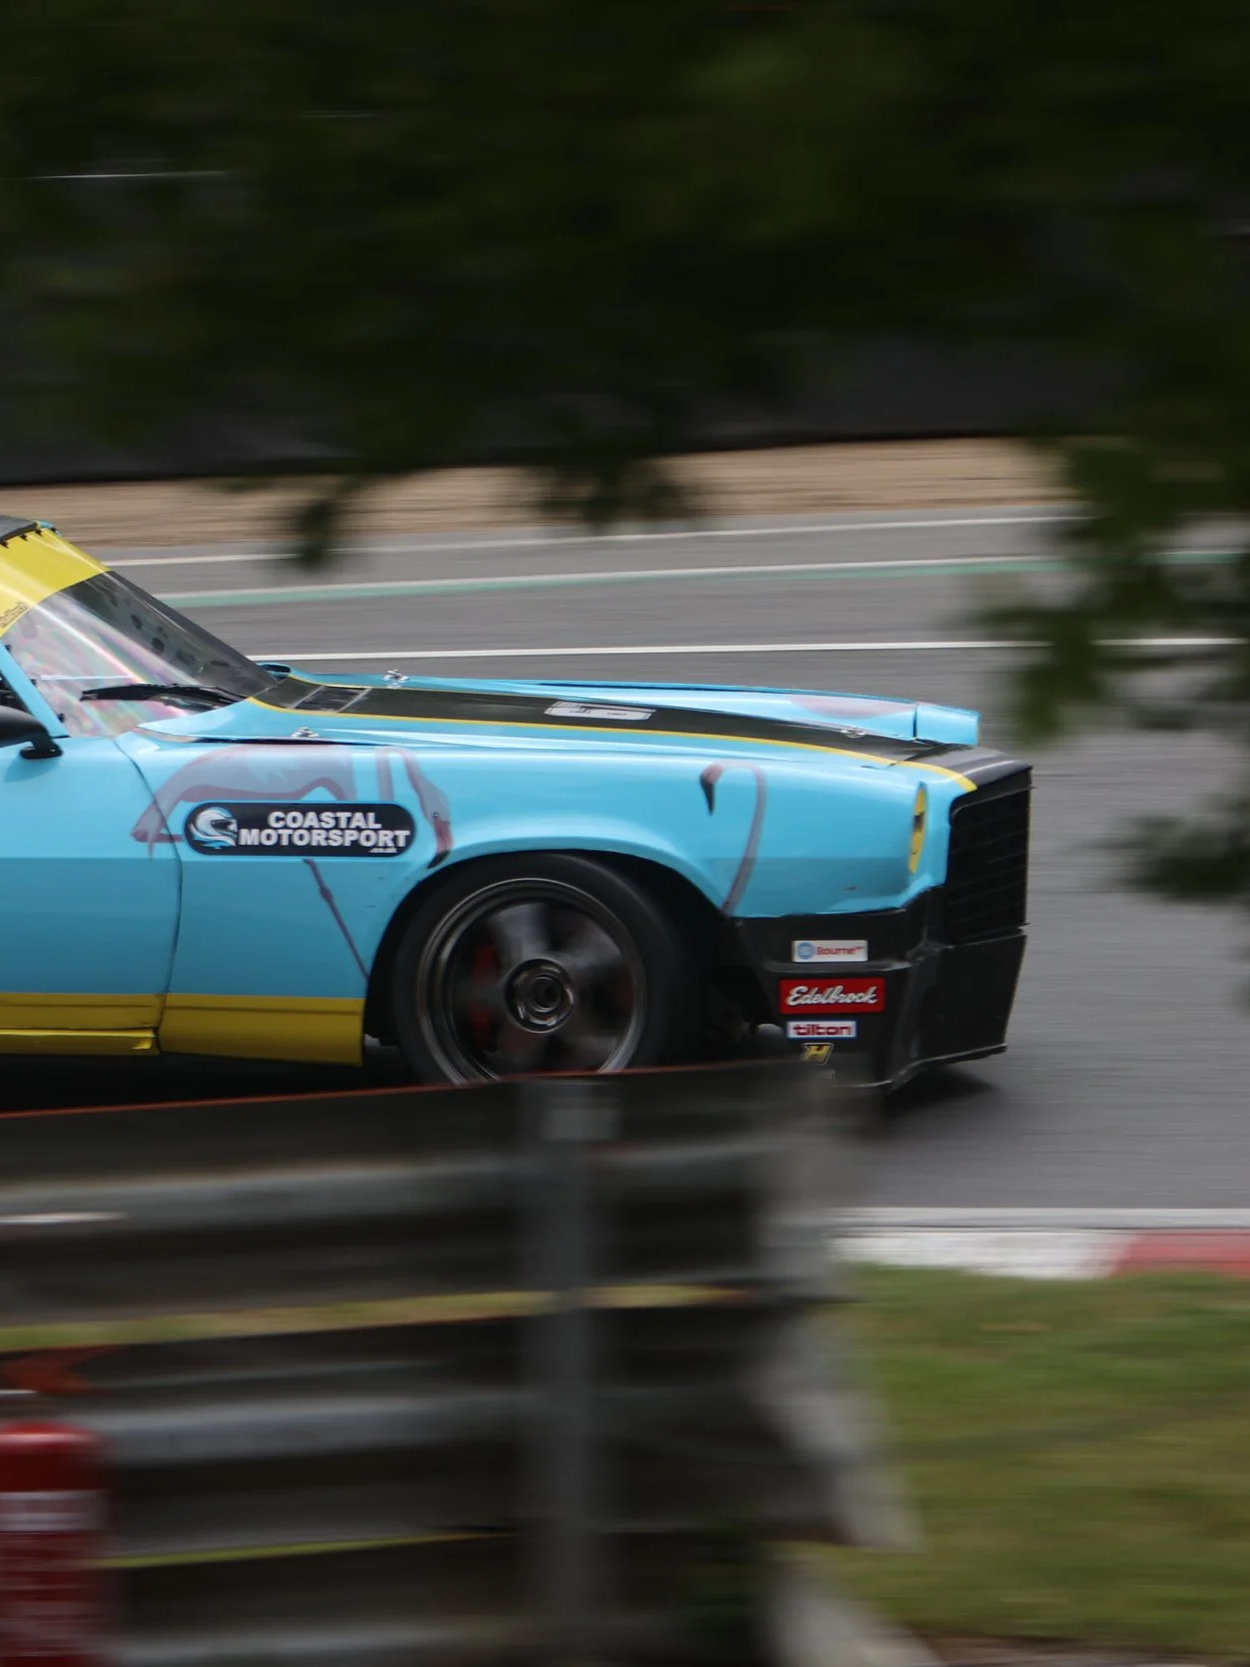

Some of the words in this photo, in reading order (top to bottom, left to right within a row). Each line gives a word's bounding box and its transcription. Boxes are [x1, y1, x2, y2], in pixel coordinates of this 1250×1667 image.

[267, 811, 382, 829] COASTAL
[238, 829, 411, 847] MOTORSPORT
[785, 985, 879, 1006] Edelbrock
[793, 1023, 852, 1036] tilton
